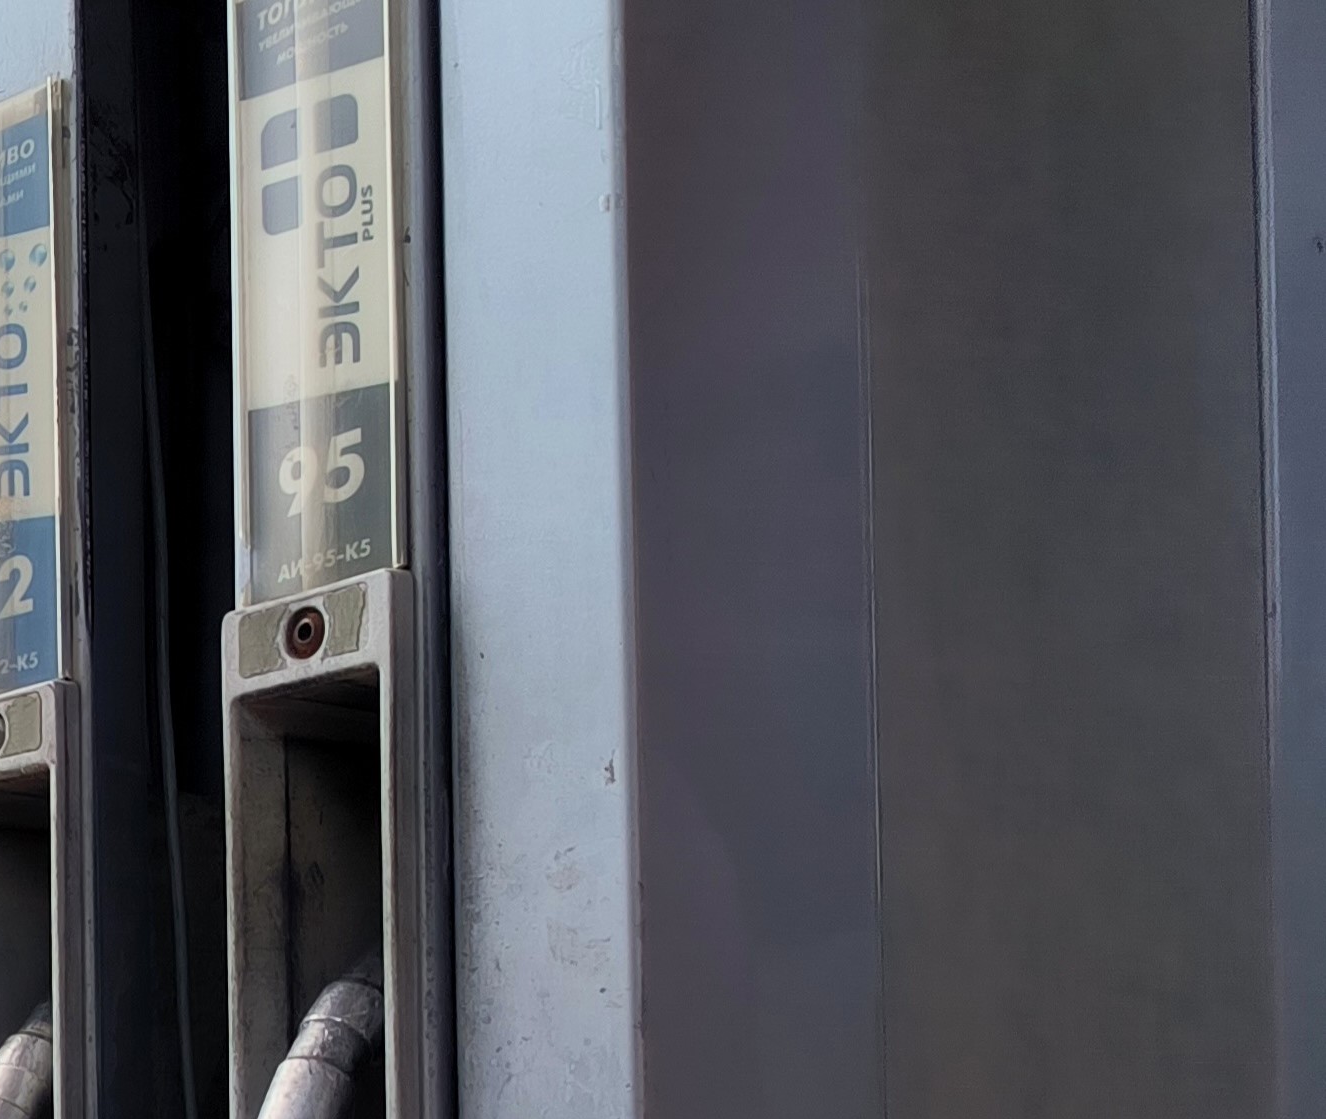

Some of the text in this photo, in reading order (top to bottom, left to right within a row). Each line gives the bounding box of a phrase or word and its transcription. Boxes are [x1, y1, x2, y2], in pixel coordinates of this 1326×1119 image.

[361, 184, 374, 241] PLUS
[316, 163, 361, 366] ЭКТО
[279, 427, 365, 518] 95
